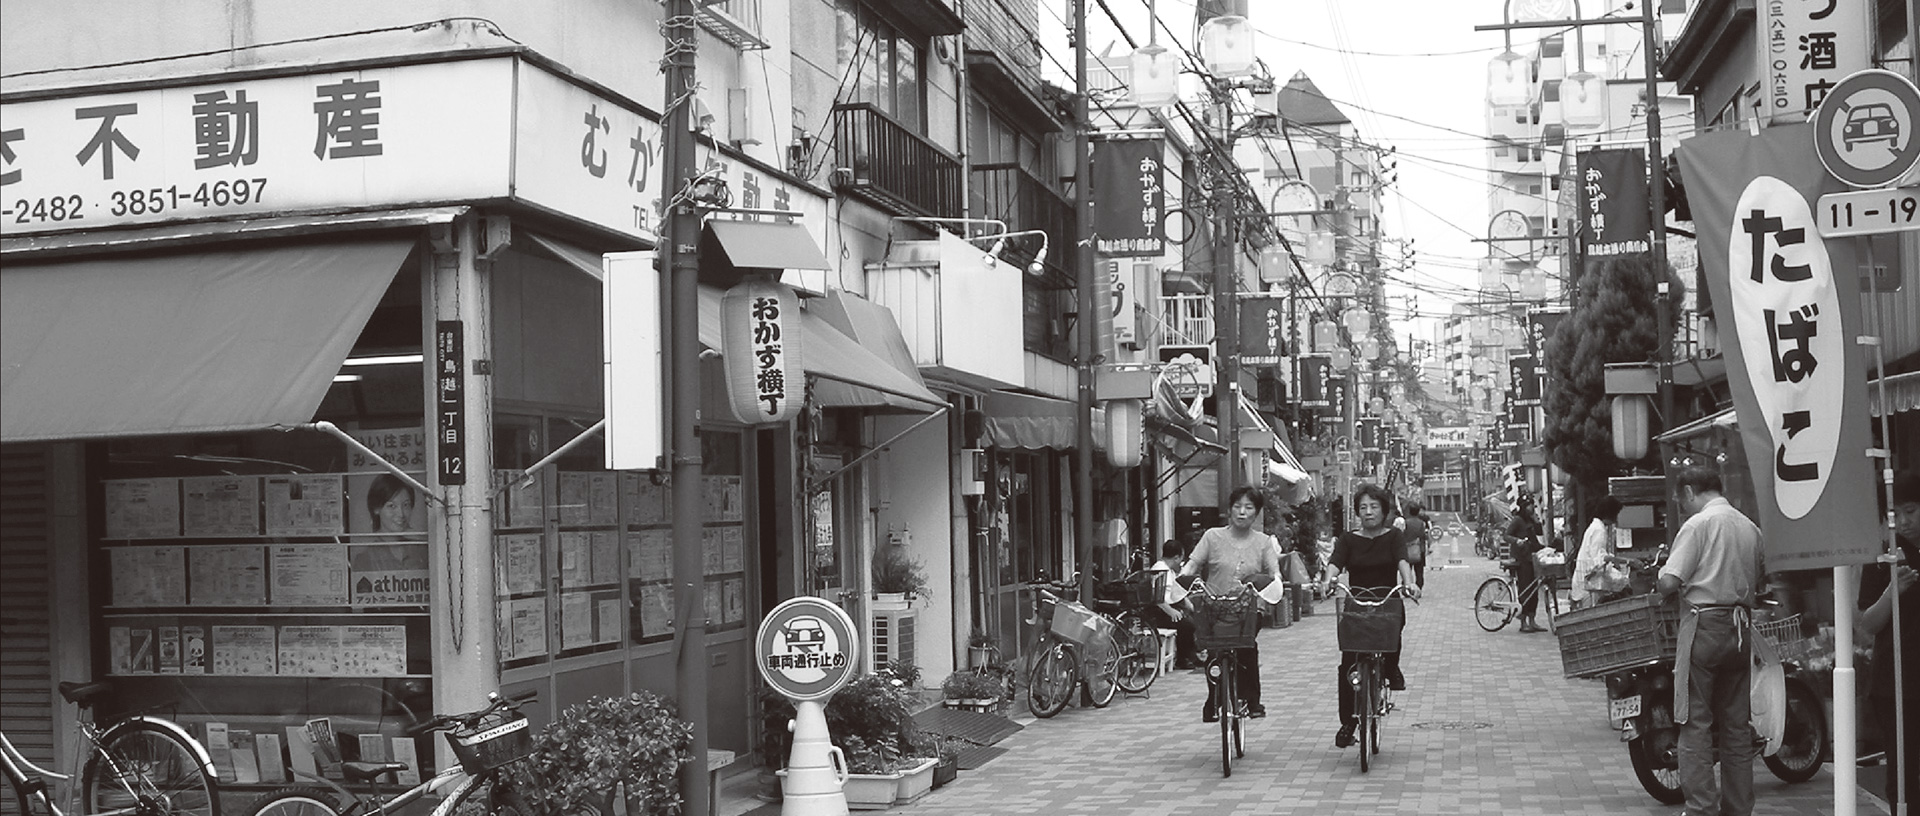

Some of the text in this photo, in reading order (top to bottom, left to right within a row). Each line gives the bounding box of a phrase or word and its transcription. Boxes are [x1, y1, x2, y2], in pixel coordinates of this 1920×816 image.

[110, 178, 268, 217] 3851-4697
[1139, 156, 1162, 236] おかず横丁
[1584, 167, 1607, 241] おかず横丁
[753, 297, 785, 416] おかず横丁
[1742, 209, 1819, 482] たばこ
[444, 359, 457, 443] 鳥越一丁目
[442, 456, 462, 474] 12
[768, 651, 845, 670] 車両通行止め
